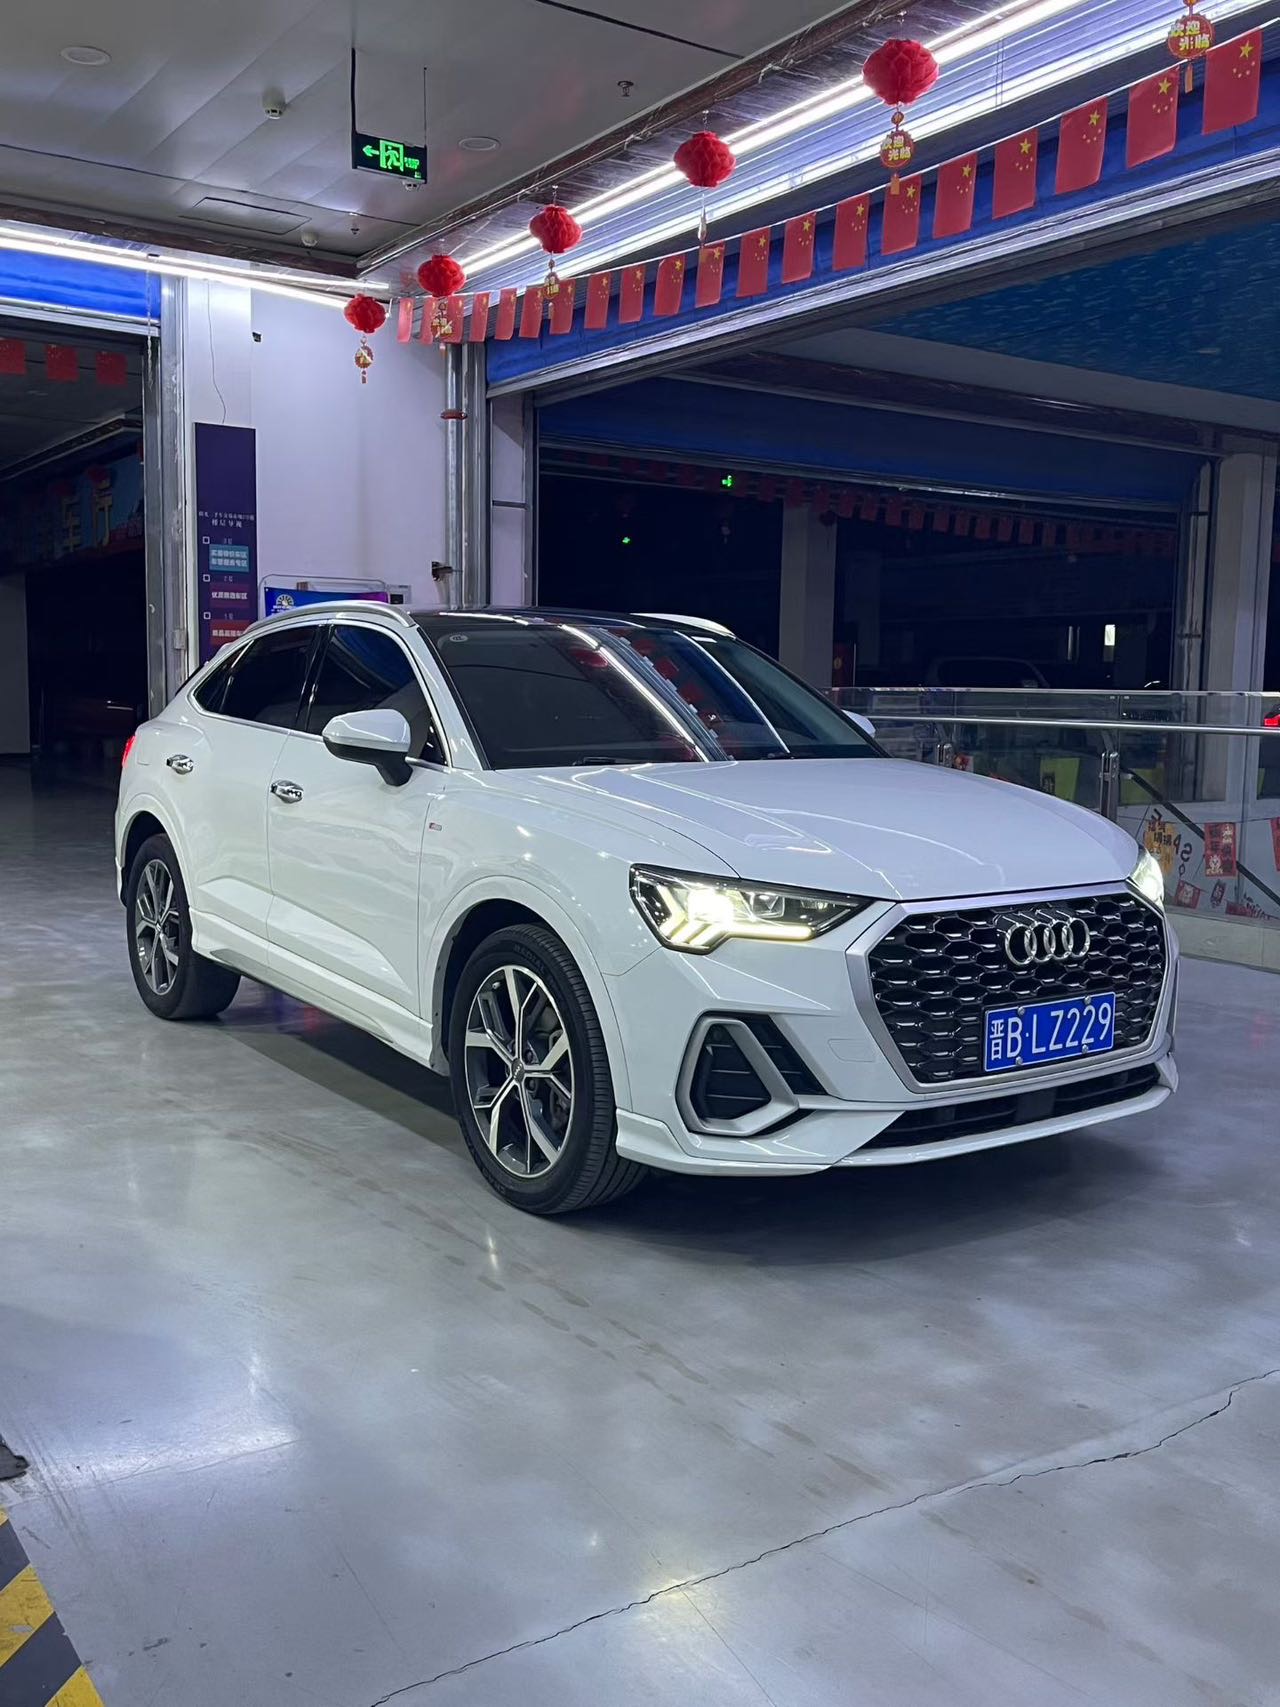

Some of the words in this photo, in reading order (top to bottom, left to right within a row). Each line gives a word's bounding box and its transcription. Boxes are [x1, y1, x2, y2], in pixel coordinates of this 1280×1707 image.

[1170, 21, 1201, 37] 欢迎
[1179, 34, 1210, 50] 光临
[881, 134, 905, 149] 欢迎
[888, 146, 911, 160] 光临
[989, 1002, 1112, 1061] 晋B·LZ229
